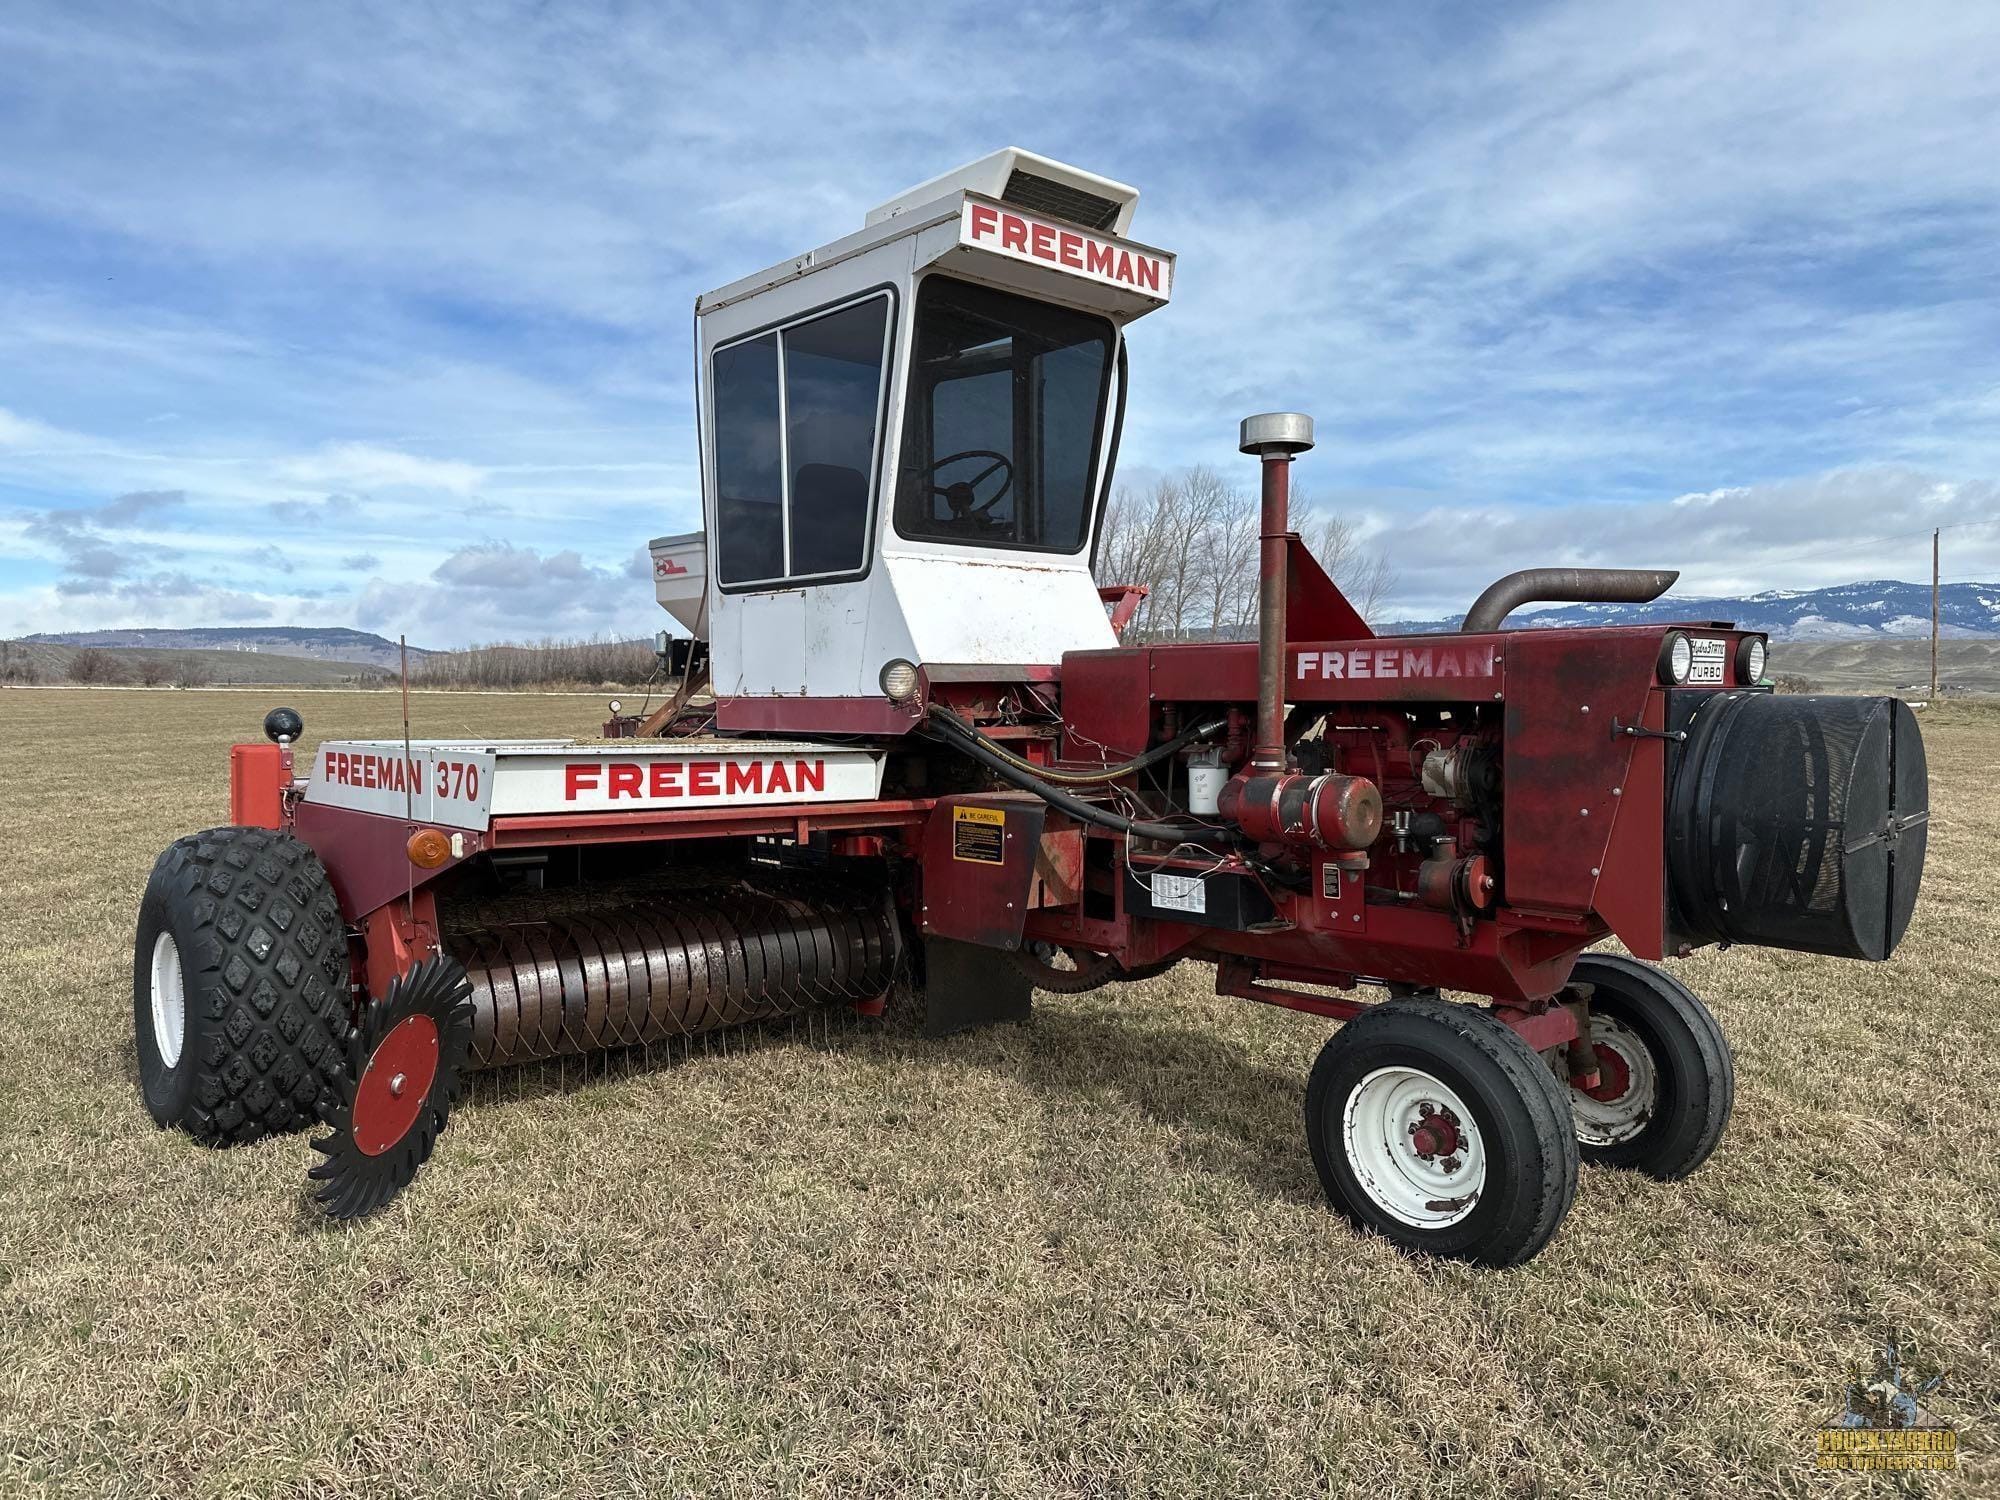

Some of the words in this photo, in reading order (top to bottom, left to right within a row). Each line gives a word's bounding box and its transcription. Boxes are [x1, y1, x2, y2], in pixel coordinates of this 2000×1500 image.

[972, 204, 1160, 291] FREEMAN
[1297, 648, 1494, 679] FREEMAN
[1692, 666, 1721, 678] TURBO
[325, 751, 422, 795] FREEMAN
[436, 761, 479, 802] 370
[565, 760, 824, 800] FREEMAN
